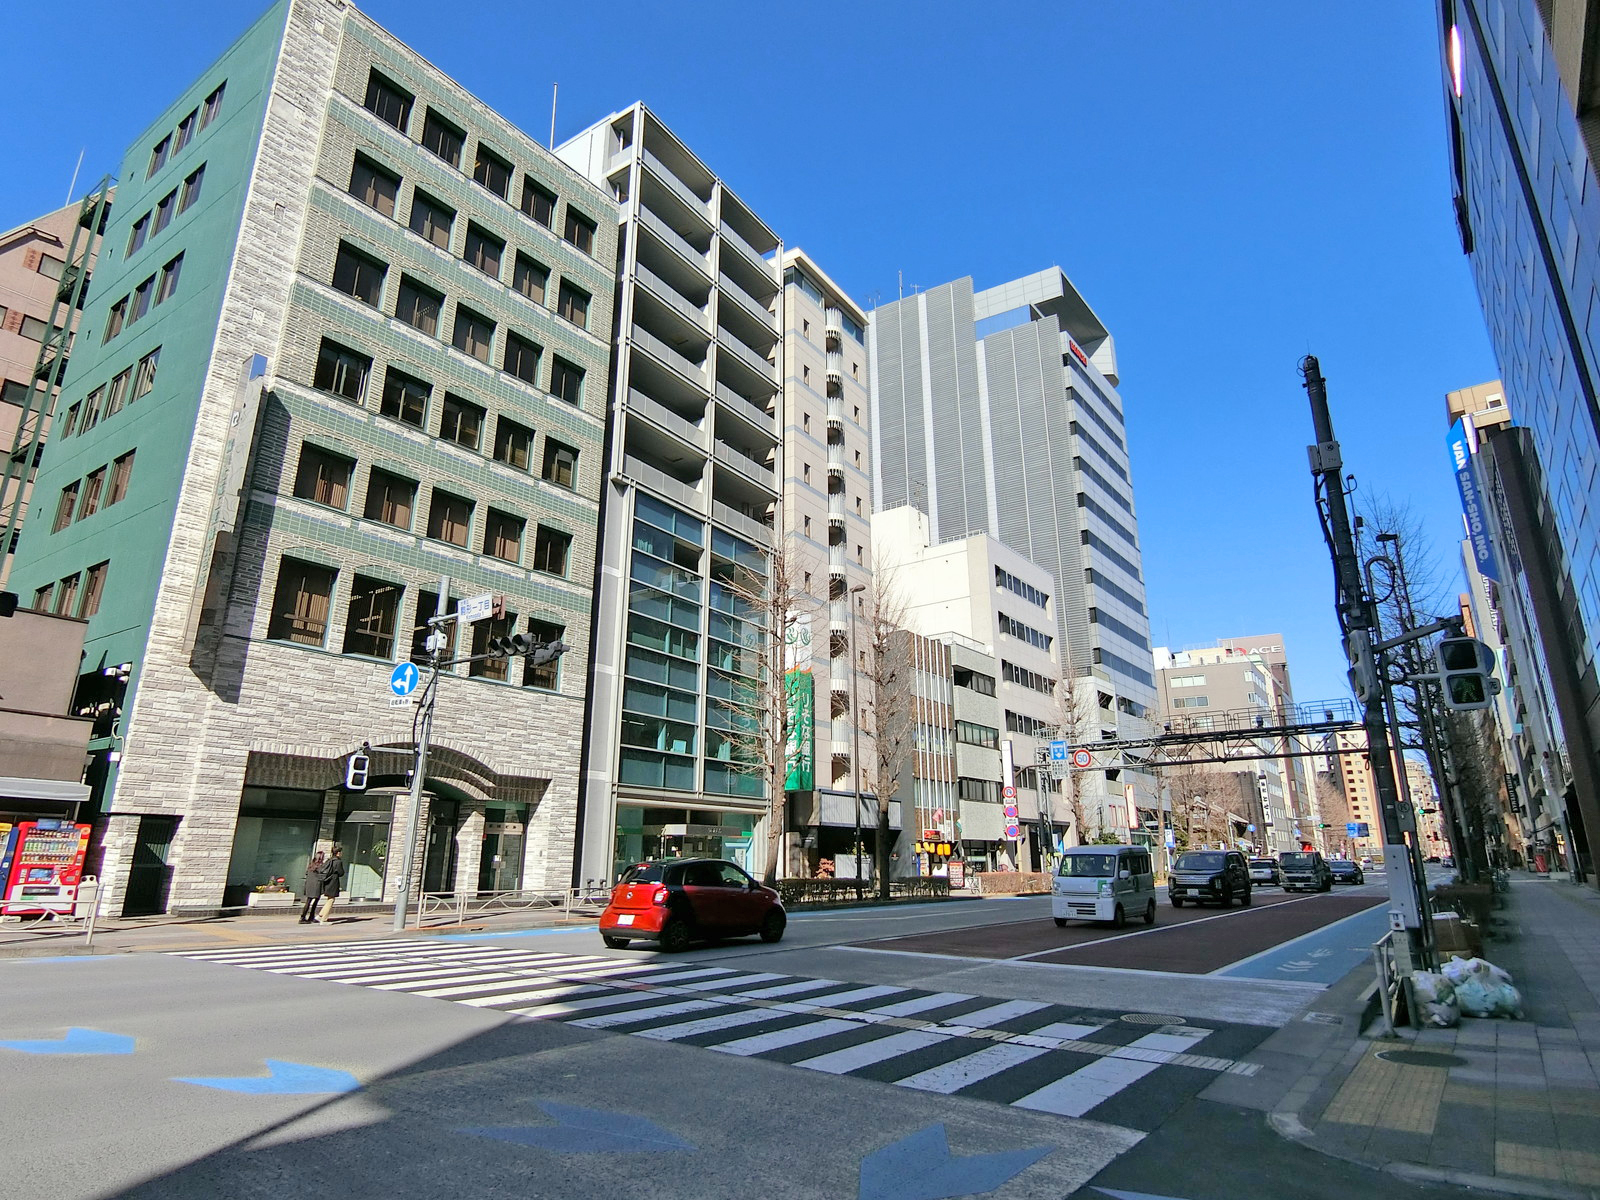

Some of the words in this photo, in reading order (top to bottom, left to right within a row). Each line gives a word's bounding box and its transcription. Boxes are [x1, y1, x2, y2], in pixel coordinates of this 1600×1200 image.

[1452, 440, 1467, 469] VAN
[1475, 534, 1489, 563] INC.
[1249, 644, 1282, 655] ACE
[801, 692, 811, 773] りそな銀行
[1077, 754, 1088, 763] 50
[1166, 830, 1171, 838] P
